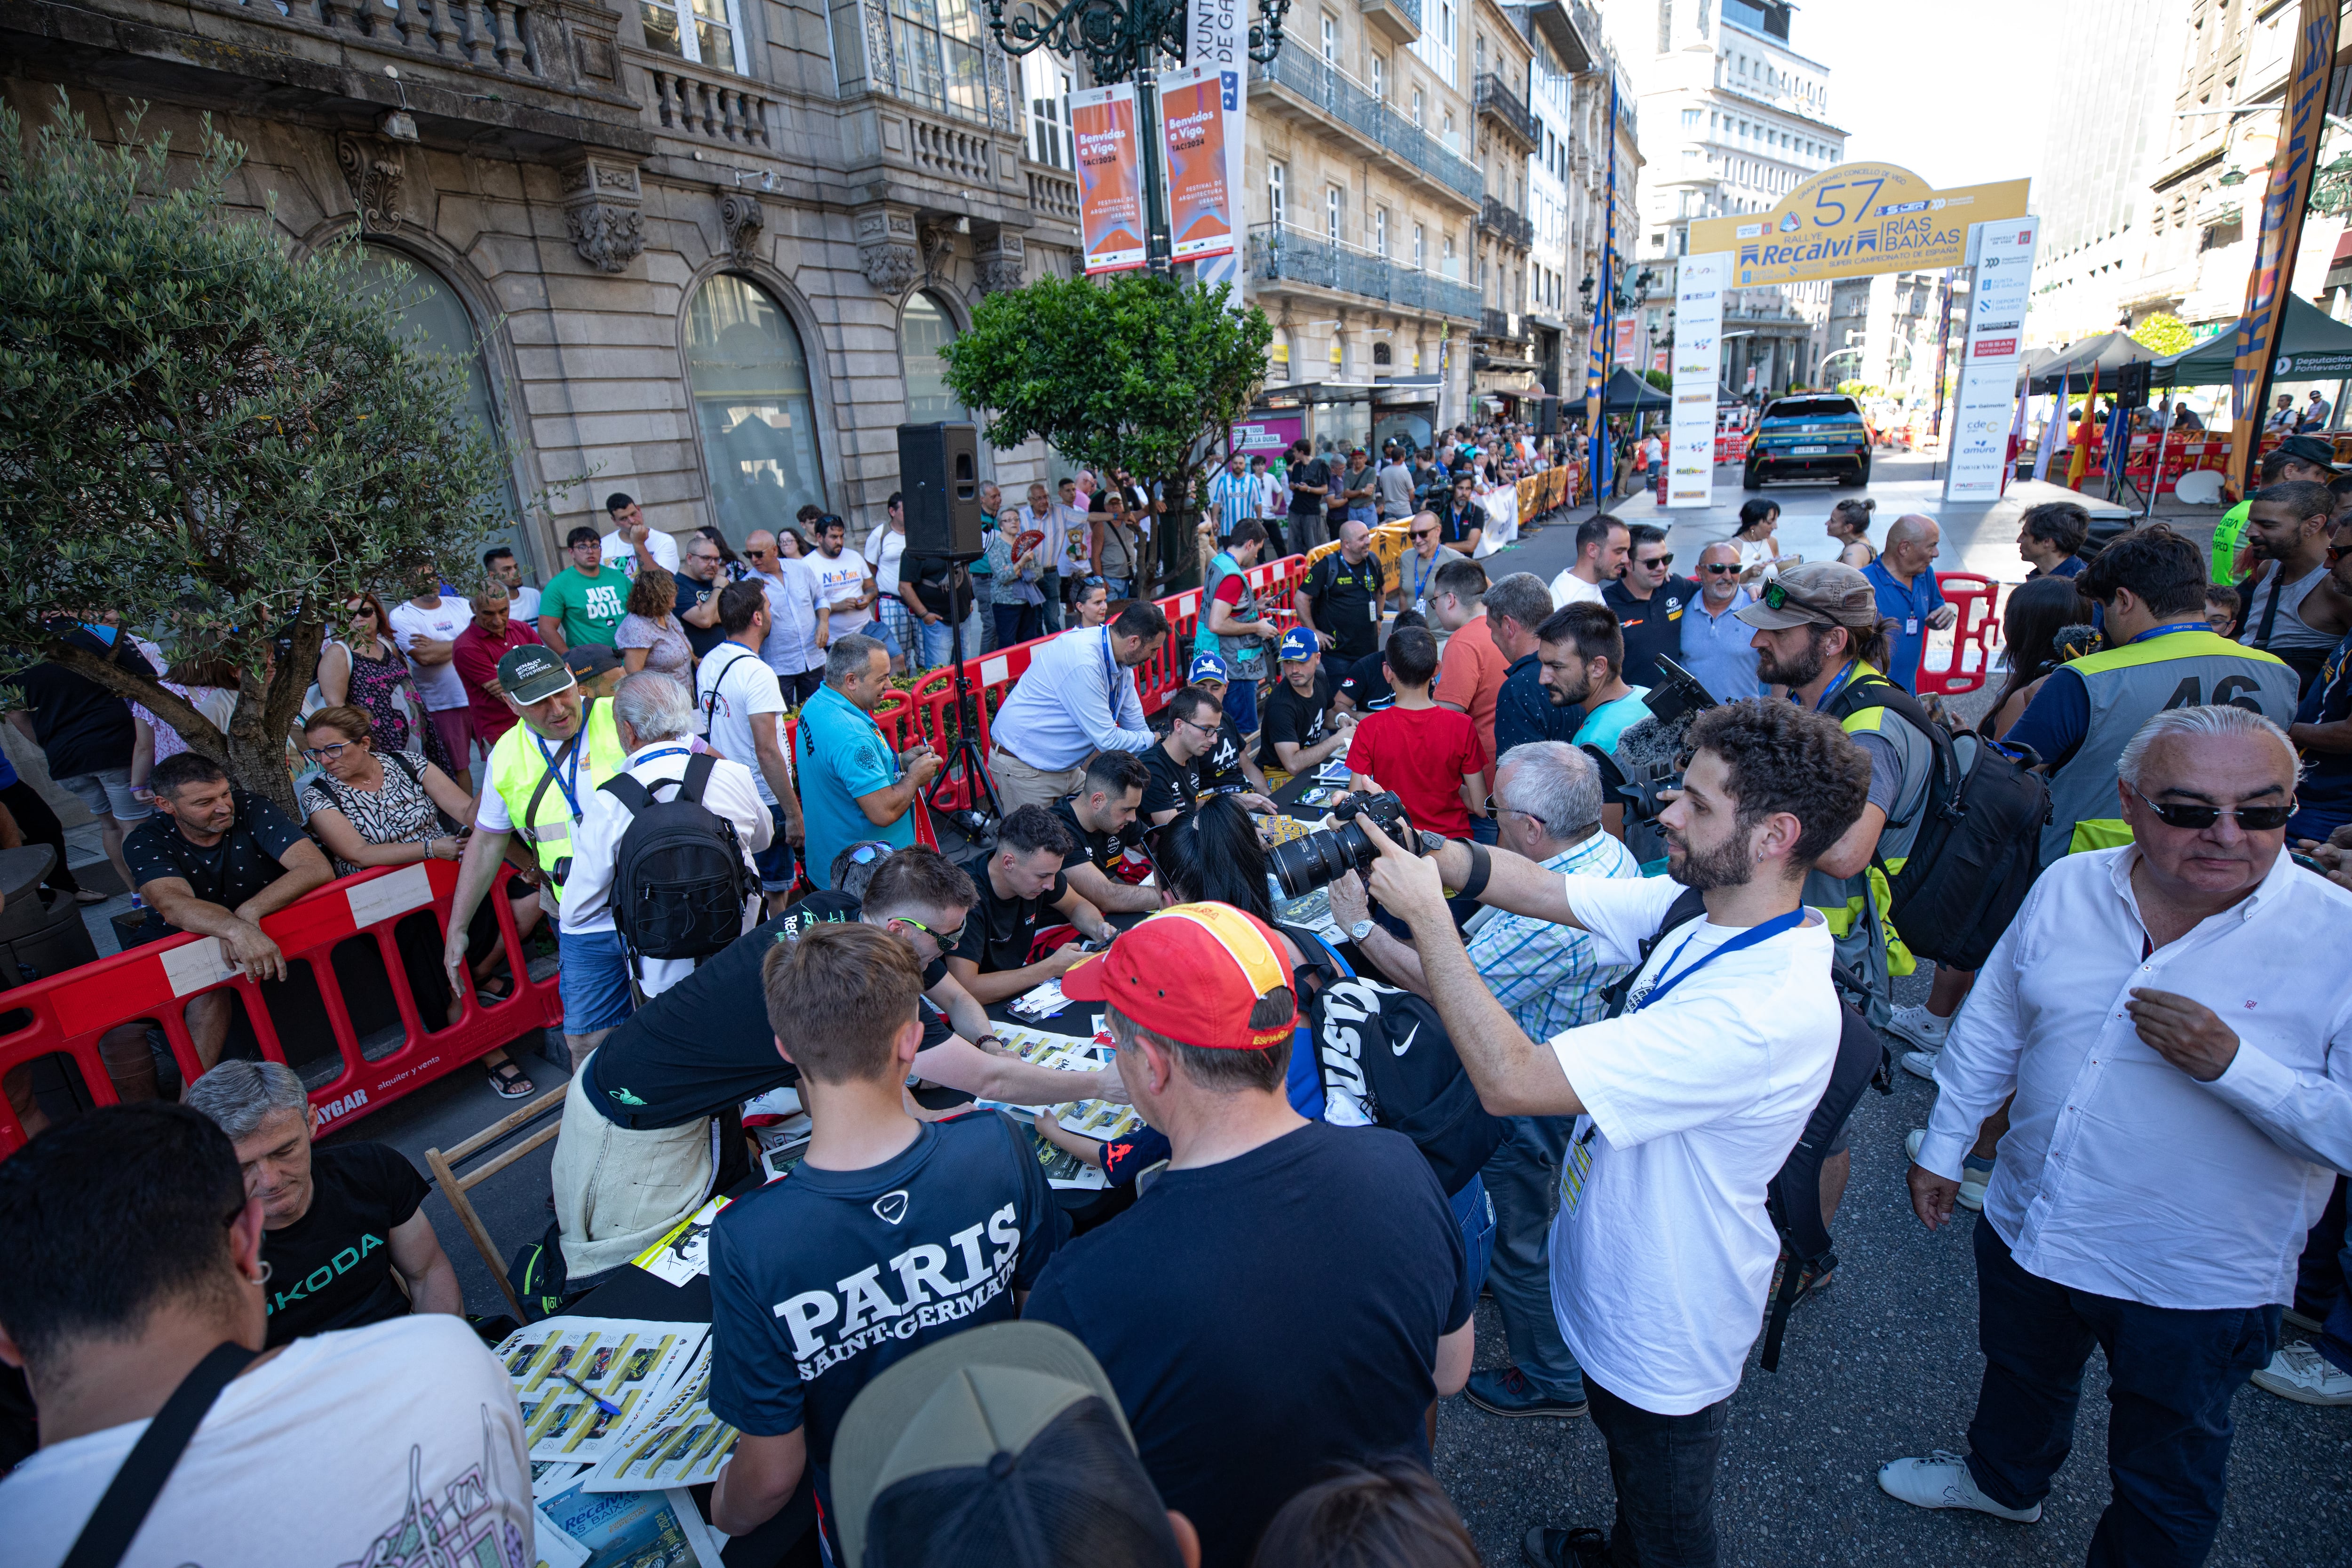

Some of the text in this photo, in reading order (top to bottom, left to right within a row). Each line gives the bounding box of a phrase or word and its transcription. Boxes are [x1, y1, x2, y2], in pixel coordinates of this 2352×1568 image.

[1217, 35, 1232, 63] DE
[1169, 110, 1214, 129] Benvidos
[1080, 128, 1126, 144] Benvidas
[1170, 125, 1205, 141] a Vigo,
[1081, 142, 1117, 156] a Vigo,
[1172, 138, 1205, 152] TAC!2024
[1082, 155, 1116, 166] TAC!2024
[1186, 183, 1212, 192] FESTIVAL
[1797, 184, 1816, 200] GRAN
[1818, 172, 1842, 187] PREMIO
[1844, 168, 1880, 177] CONCELLO
[1892, 173, 1906, 185] VIGO
[1098, 197, 1124, 207] FESTIVAL
[1178, 188, 1223, 202] ARQUITECTURA
[1199, 196, 1223, 205] URBANA
[1813, 178, 1885, 227] 57
[1090, 203, 1135, 215] ARQUITECTURA
[1887, 216, 1932, 236] RÍAS
[1784, 232, 1822, 244] RALLYE
[1885, 229, 1961, 252] BAIXAS
[1761, 235, 1854, 266] Recalvi
[1829, 259, 1852, 267] SÚPER
[1854, 252, 1910, 264] CAMPEONATO
[1926, 246, 1959, 256] ESPAÑA
[2294, 363, 2352, 373] Pontevedra
[2296, 355, 2352, 366] Deputación
[586, 585, 616, 604] JUST
[586, 600, 624, 619] DO IT.
[515, 658, 541, 673] RENAULT
[517, 664, 538, 676] SPORT
[519, 663, 552, 680] EXPERIENCE
[575, 666, 593, 676] Recalvi
[2161, 676, 2263, 716] 46
[1253, 1030, 1289, 1046] ESPAÑA
[378, 1071, 409, 1091] alquiler
[417, 1057, 440, 1072] venta
[772, 1202, 1021, 1361] PARIS
[797, 1252, 1019, 1381] SAINT-GERMAIN
[624, 1375, 699, 1449] autógrafo?
[650, 1384, 699, 1430] firmas
[569, 1493, 641, 1537] AS BAIXAS
[609, 1504, 647, 1529] suplemento
[609, 1508, 648, 1534] ESPECIAL
[578, 1526, 595, 1540] PREMIO
[595, 1513, 618, 1528] CONCELLO
[655, 1511, 686, 1563] 4 5 6 julio 2024
